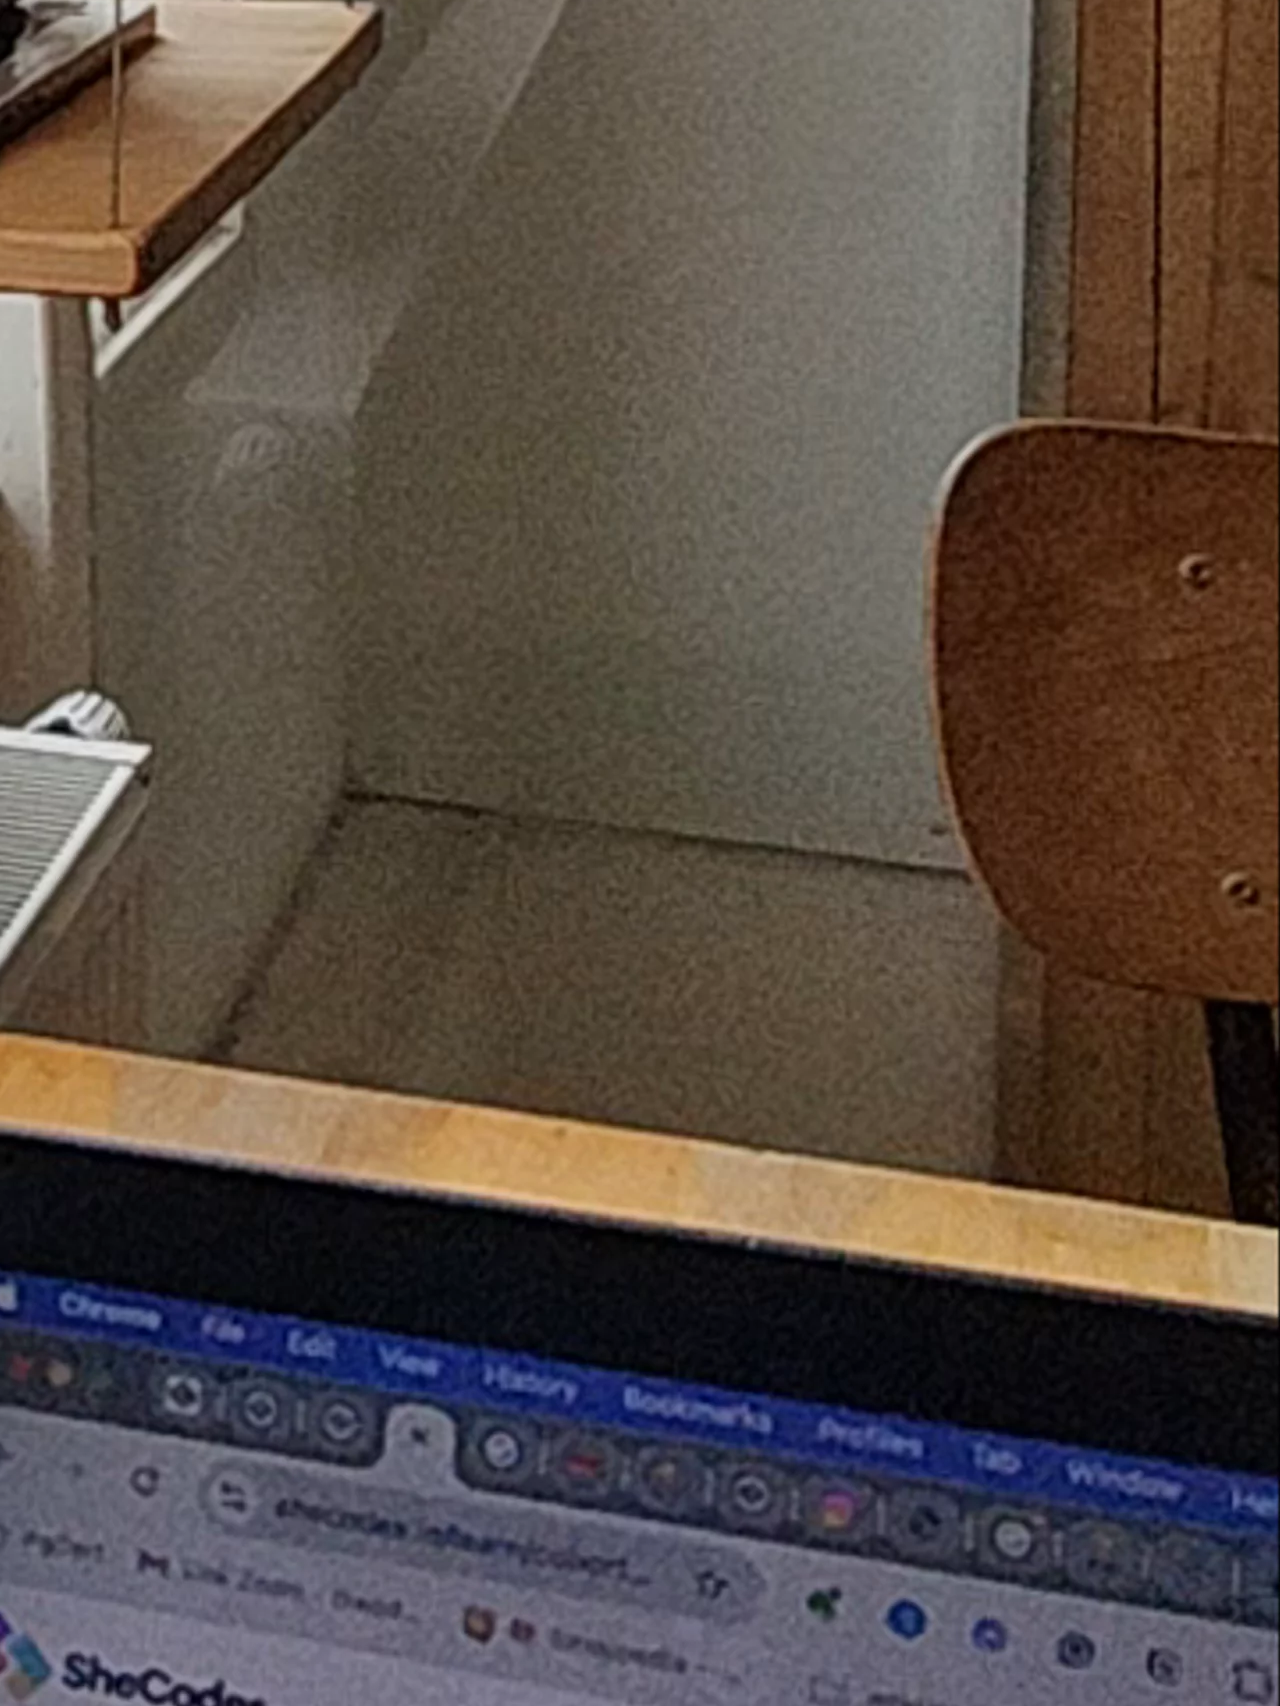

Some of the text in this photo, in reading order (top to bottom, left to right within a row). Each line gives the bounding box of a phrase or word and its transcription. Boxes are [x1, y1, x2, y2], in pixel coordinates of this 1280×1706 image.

[58, 1290, 163, 1332] Chrome
[200, 1313, 246, 1344] File
[286, 1328, 337, 1360] Edit
[378, 1343, 440, 1378] View
[483, 1363, 577, 1406] History
[623, 1385, 773, 1435] Bookmarks
[818, 1414, 924, 1459] Profiles
[973, 1439, 1023, 1475] Tab
[1065, 1456, 1184, 1504] Window
